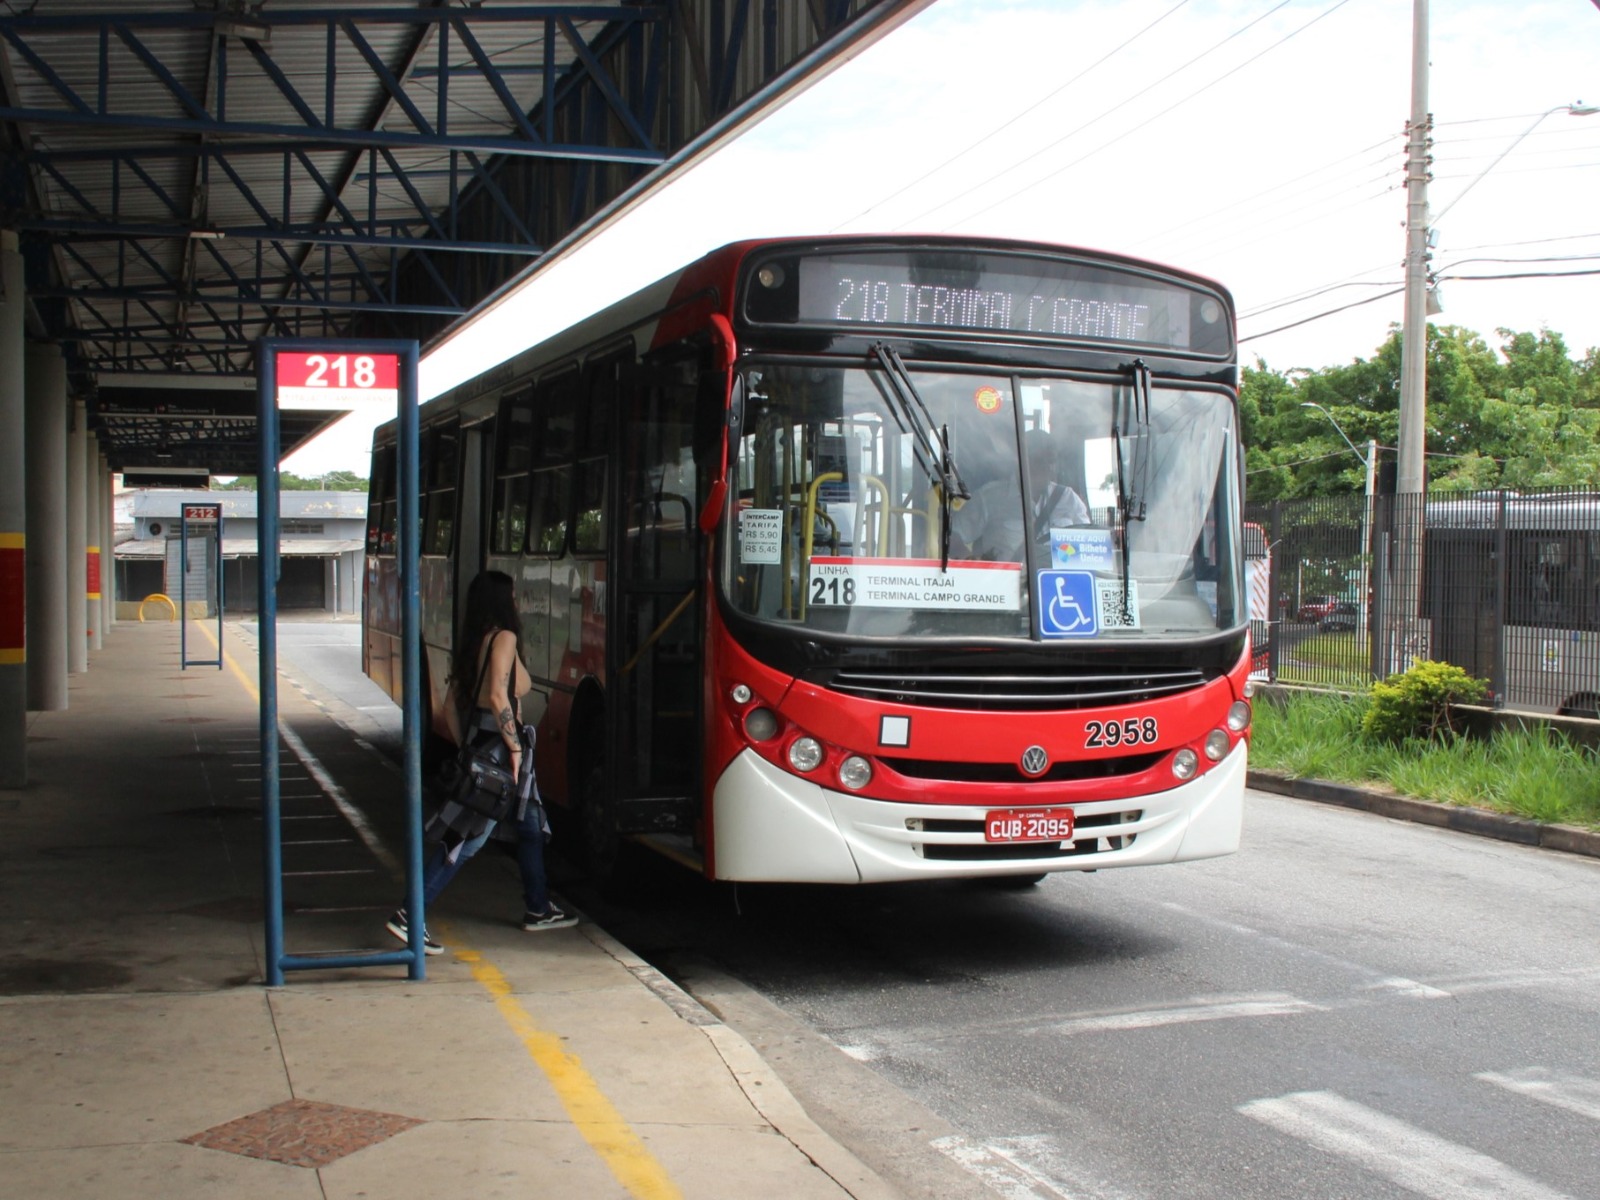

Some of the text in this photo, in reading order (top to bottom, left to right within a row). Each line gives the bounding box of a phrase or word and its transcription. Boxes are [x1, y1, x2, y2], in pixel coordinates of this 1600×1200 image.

[836, 278, 889, 322] 218
[305, 355, 376, 388] 218
[190, 509, 214, 518] 212
[745, 530, 778, 540] R$ 5,90
[745, 544, 777, 554] R$ 5,45
[818, 566, 849, 575] LINHA
[867, 576, 921, 586] TERMINAL
[811, 577, 857, 605] 218
[867, 590, 1006, 604] TERMINAL CAMPO GRANDE
[1084, 716, 1158, 749] 2958
